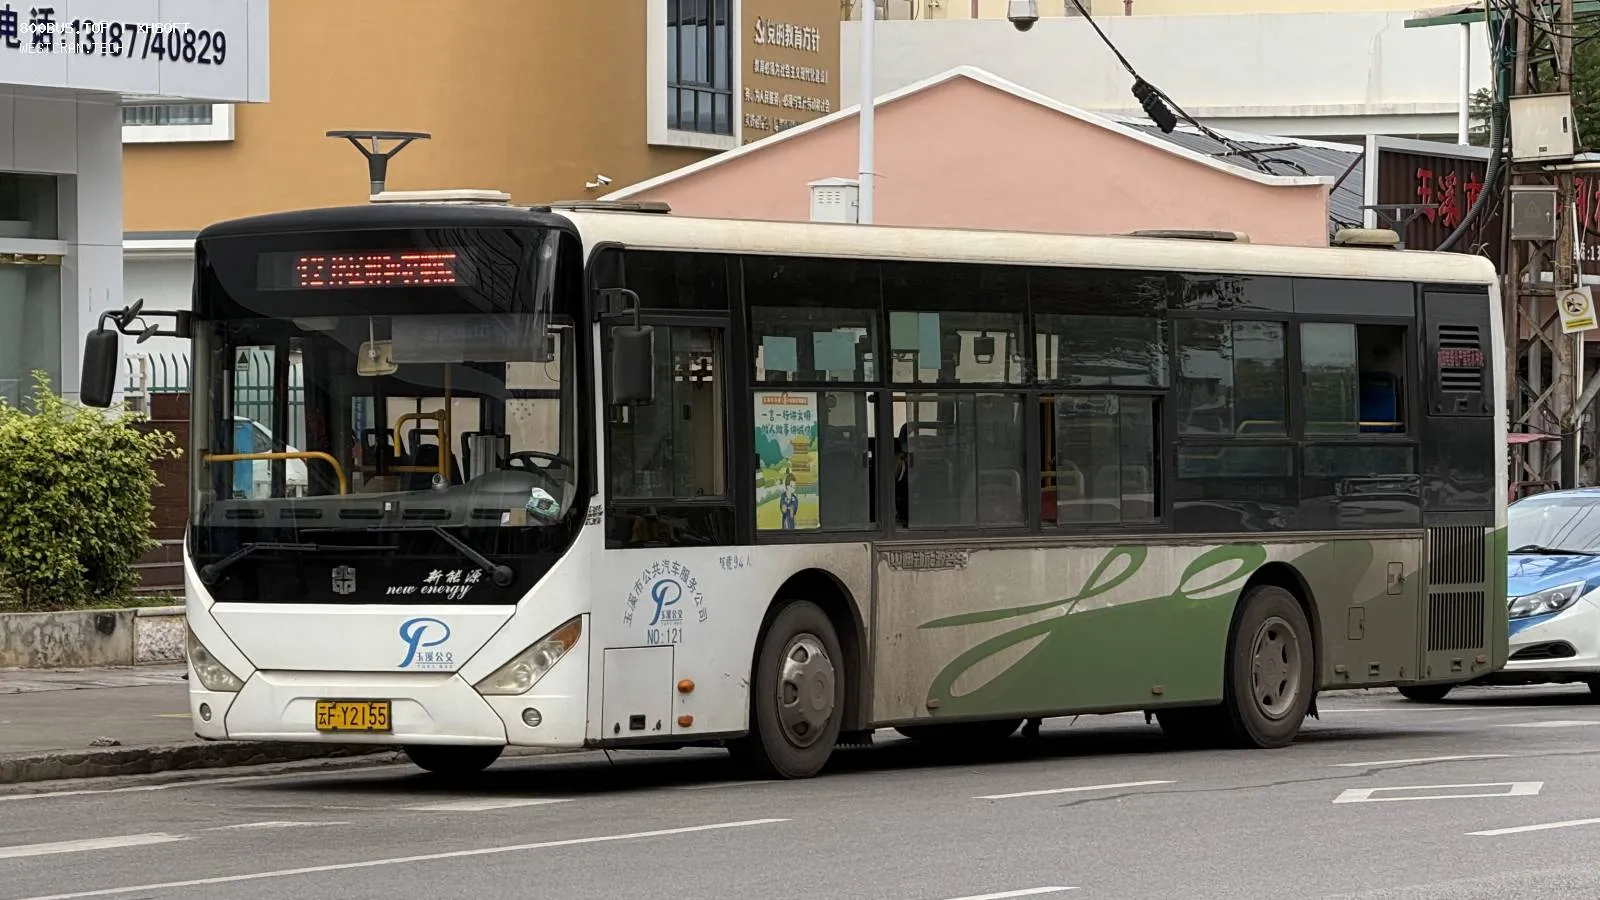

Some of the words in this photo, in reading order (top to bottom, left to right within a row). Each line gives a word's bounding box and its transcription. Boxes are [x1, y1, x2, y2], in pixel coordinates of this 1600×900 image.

[767, 19, 820, 52] 党的教育方针
[423, 569, 482, 585] 新能源
[386, 586, 418, 595] new
[420, 584, 473, 600] energy
[623, 559, 708, 629] 玉溪市公共汽车服务公司
[647, 627, 683, 645] NO:121
